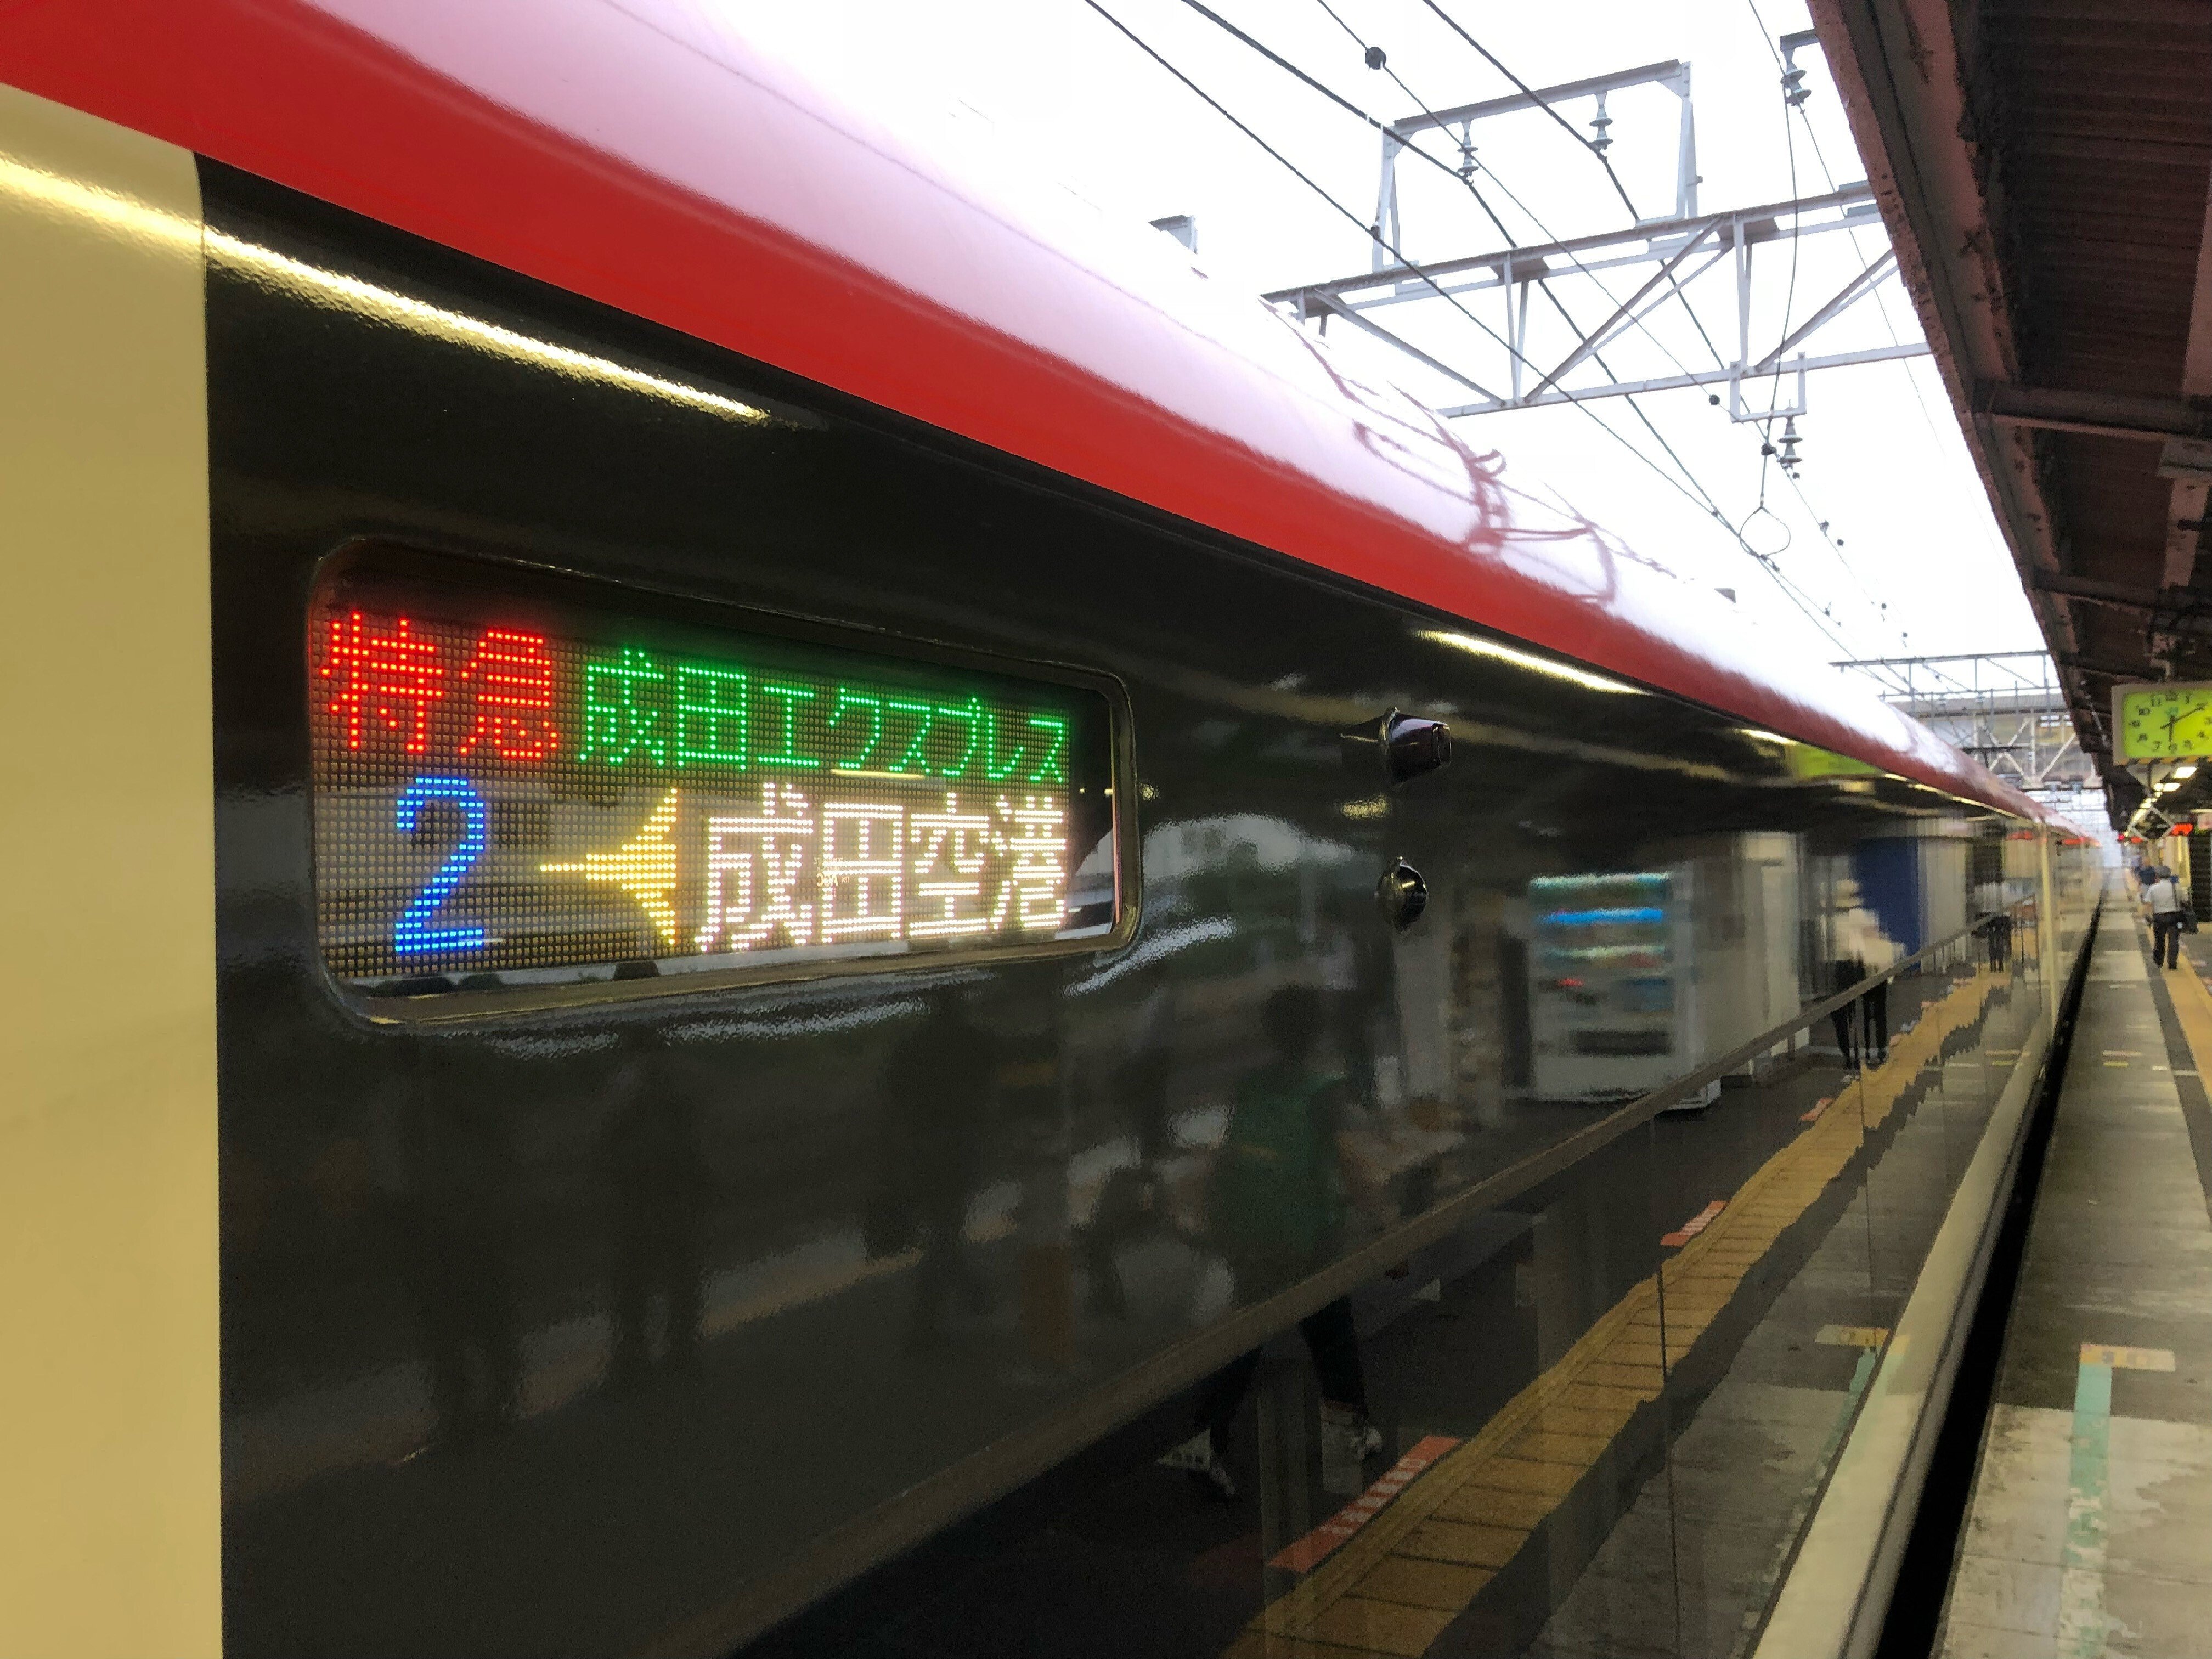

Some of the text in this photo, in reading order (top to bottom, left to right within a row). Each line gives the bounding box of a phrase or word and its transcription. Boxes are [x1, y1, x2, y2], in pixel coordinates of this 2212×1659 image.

[317, 611, 1066, 785] 特急 成田エクスプレス
[395, 777, 486, 955] 2
[694, 782, 1066, 951] 成田空港
